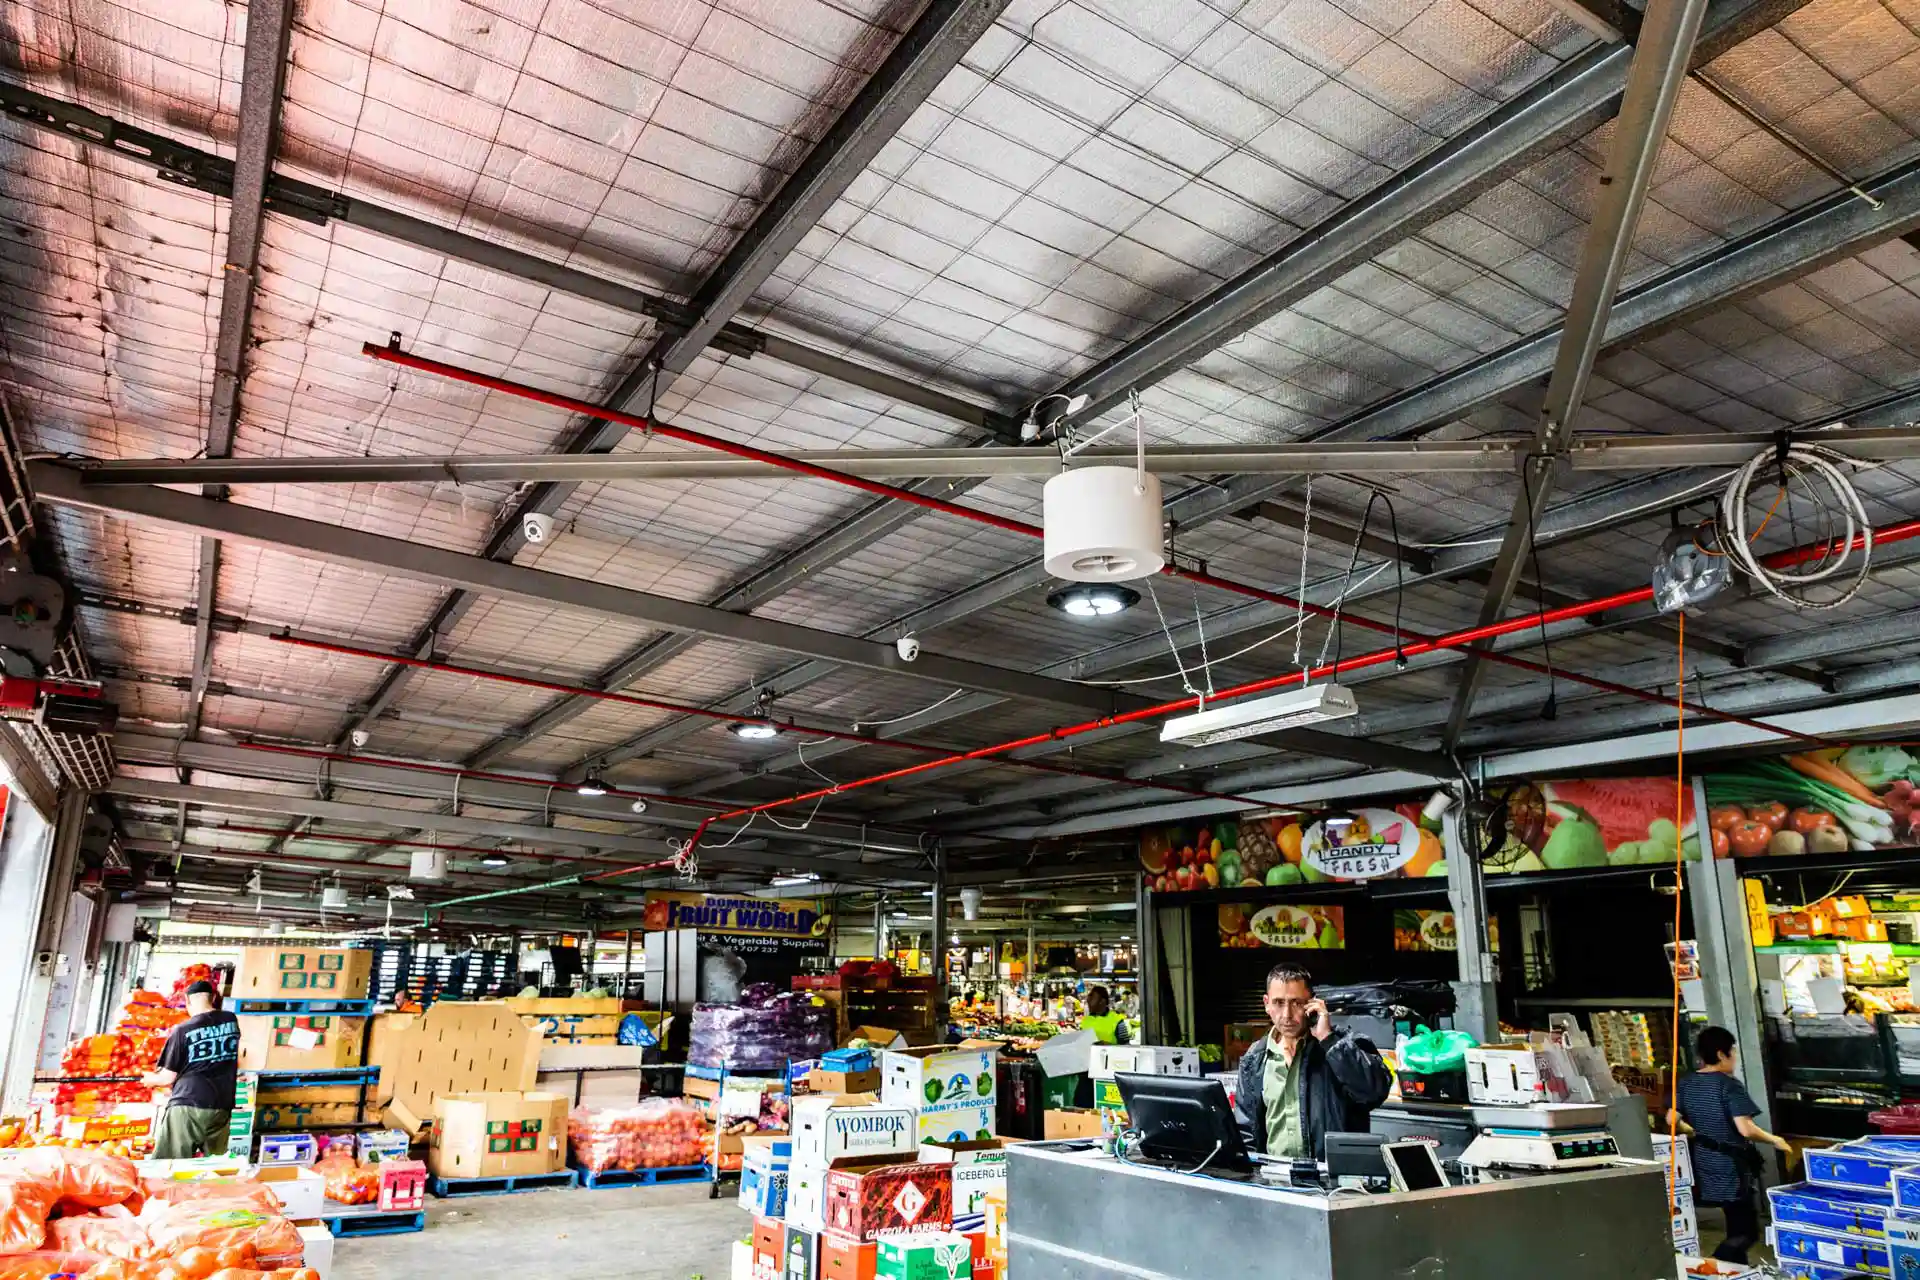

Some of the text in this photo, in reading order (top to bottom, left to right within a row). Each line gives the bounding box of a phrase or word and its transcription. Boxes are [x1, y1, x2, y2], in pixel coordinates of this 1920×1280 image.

[1330, 845, 1384, 856] DANDY
[1331, 857, 1390, 874] FRESH
[706, 898, 780, 911] DOMENICS
[668, 901, 816, 934] FRUIT WORLD
[709, 935, 718, 943] &
[723, 936, 779, 946] Vegetable
[782, 938, 824, 948] Supplies
[1268, 934, 1300, 944] FRES
[921, 1102, 958, 1114] HARMY'S
[835, 1116, 905, 1132] WOMBOK
[957, 1170, 995, 1180] ICEBERG
[866, 1227, 909, 1240] GAZZOLA
[911, 1222, 942, 1234] FARMS
